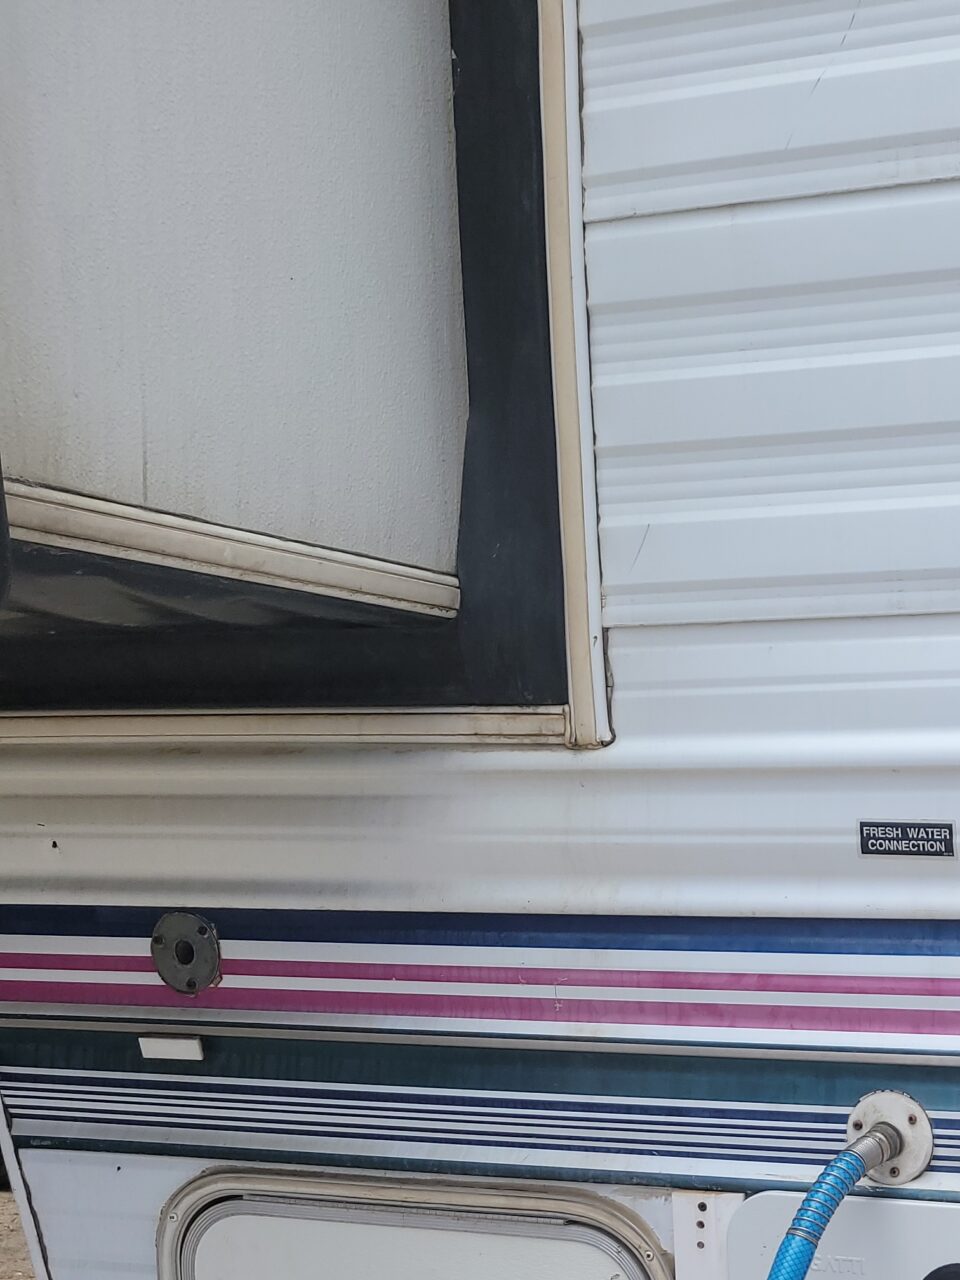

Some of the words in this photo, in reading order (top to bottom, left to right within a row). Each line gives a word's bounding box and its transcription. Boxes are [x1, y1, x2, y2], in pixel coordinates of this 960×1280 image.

[862, 826, 902, 838] FRESH
[906, 827, 950, 840] WATER
[868, 839, 946, 852] CONNECTION
